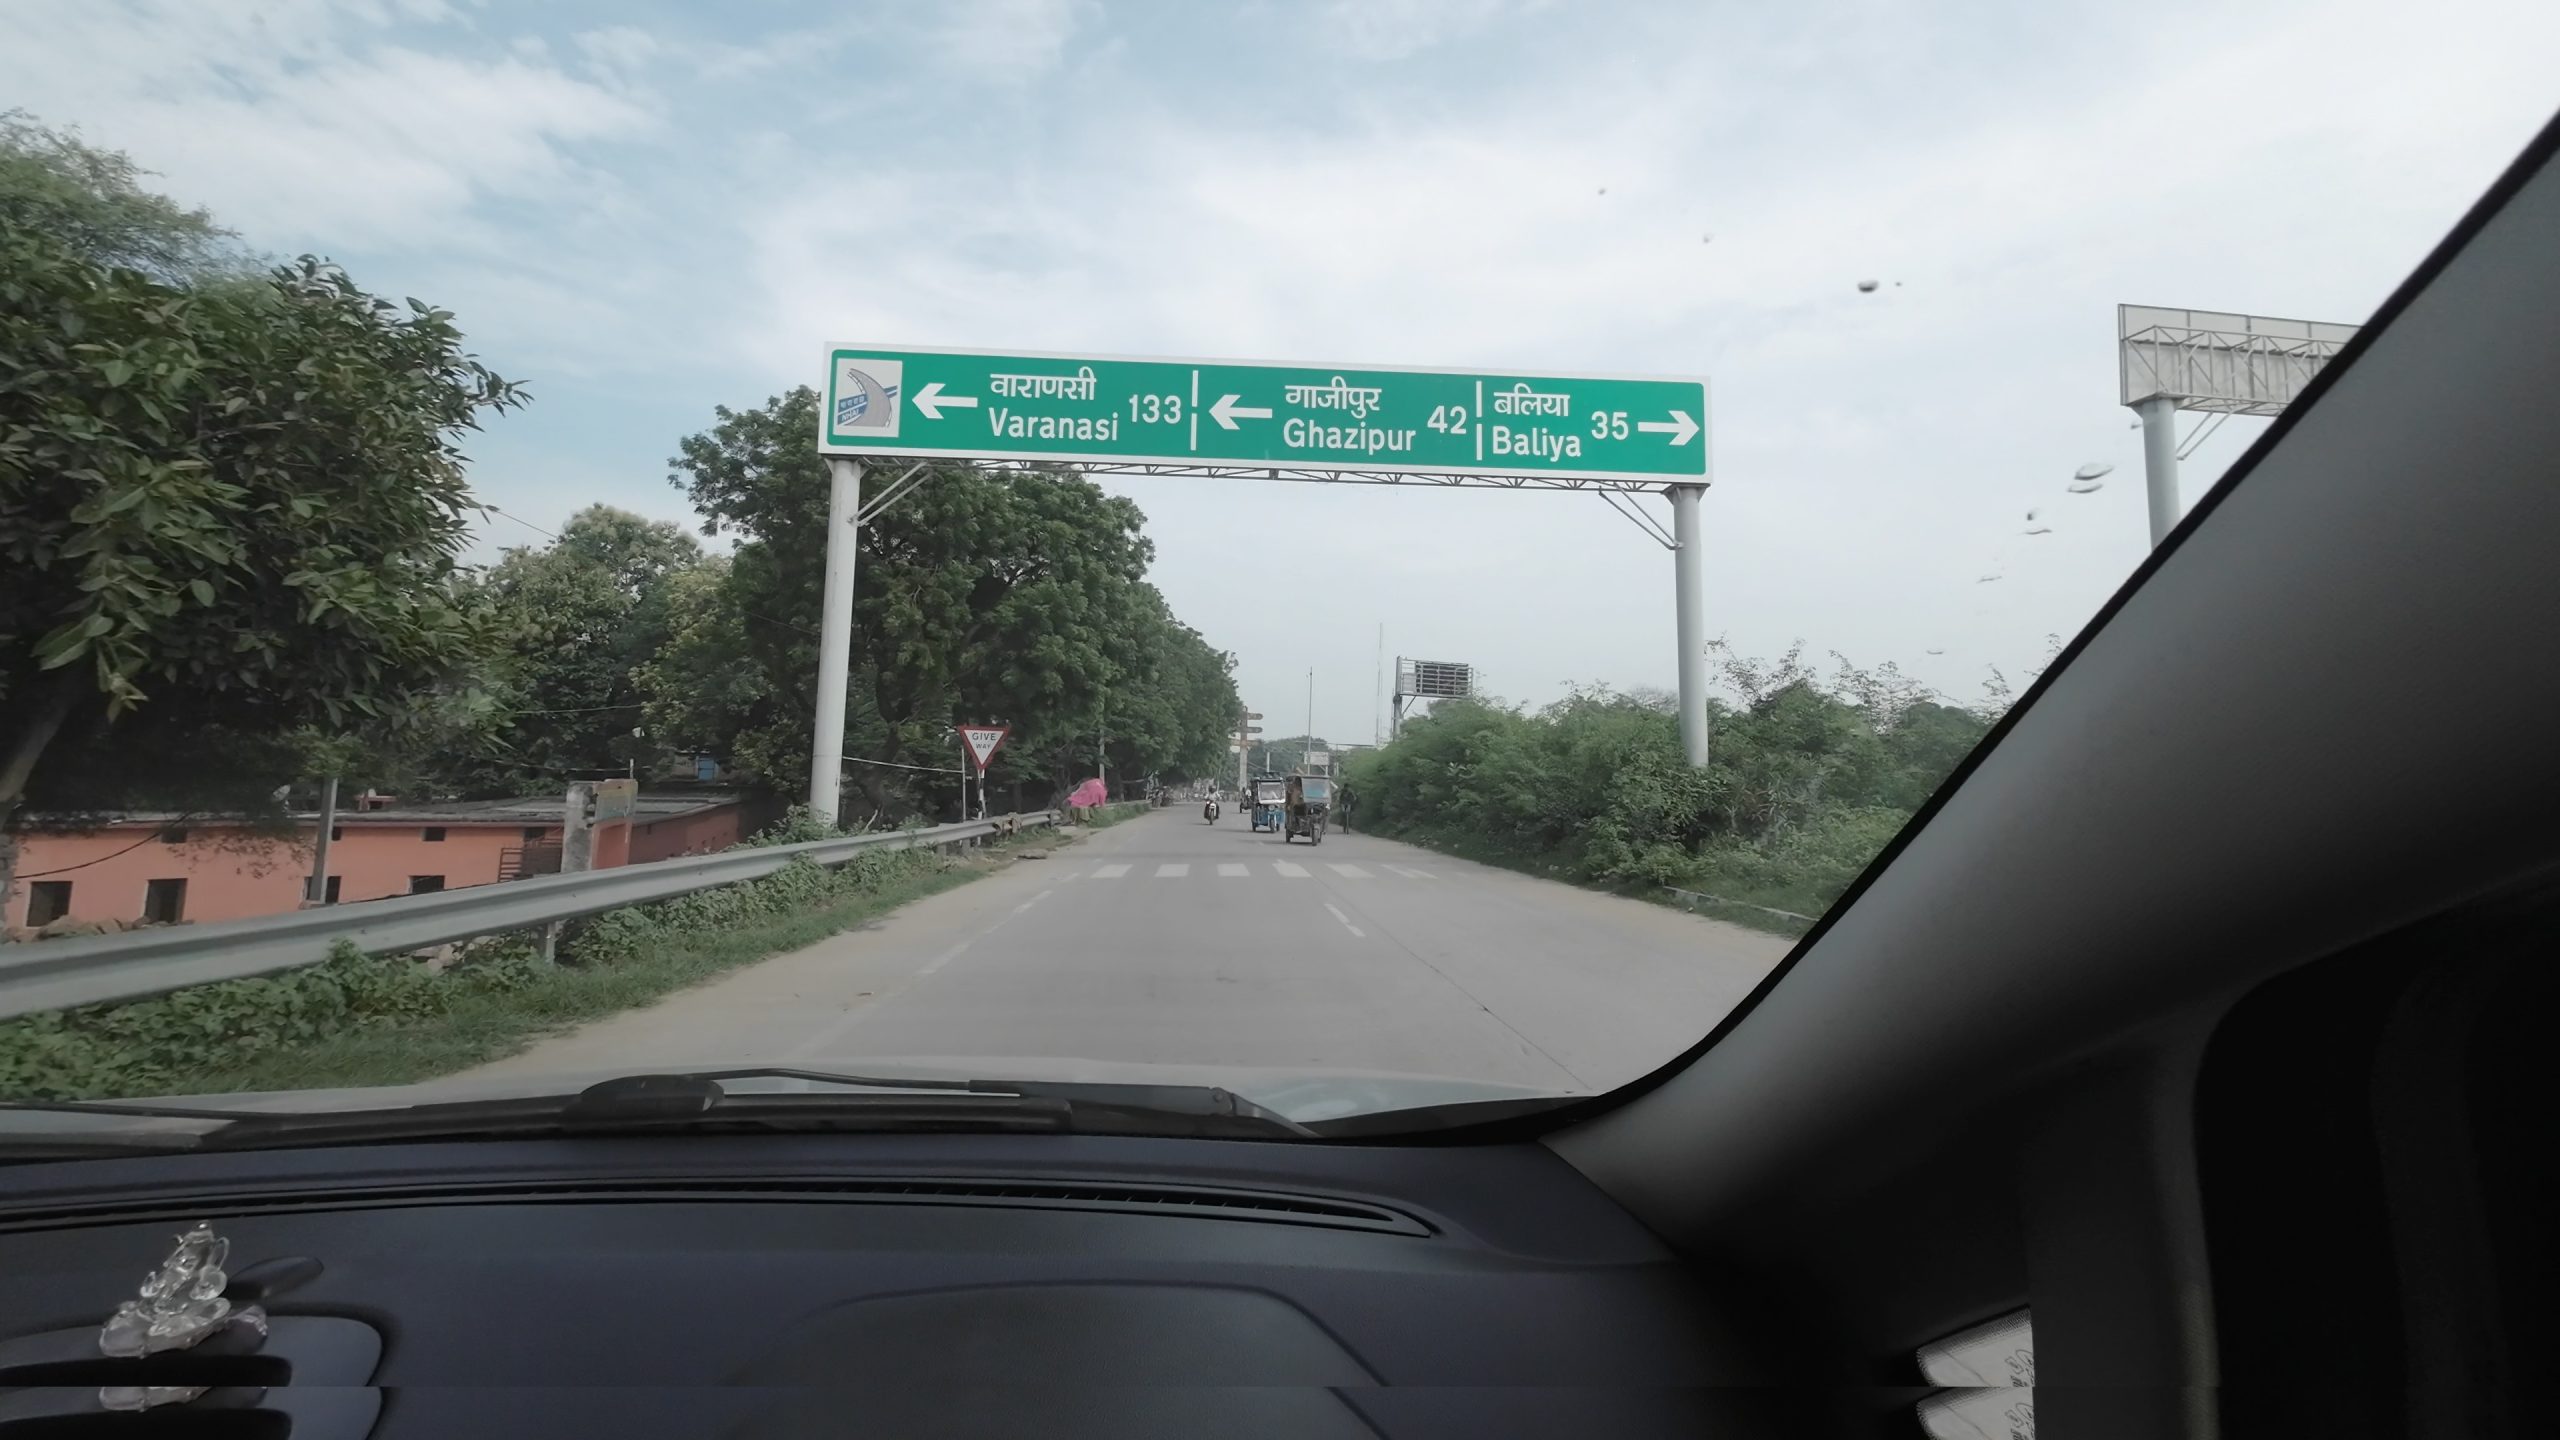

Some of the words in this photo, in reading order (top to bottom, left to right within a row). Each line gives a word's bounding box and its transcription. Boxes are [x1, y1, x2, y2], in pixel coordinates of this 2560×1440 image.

[990, 366, 1097, 401] वाराणसी
[1284, 375, 1383, 420] गाजीपुर
[1493, 382, 1571, 418] बलिया
[988, 407, 1119, 442] Varanasi
[1129, 394, 1182, 424] 133
[1427, 405, 1467, 435] 42
[1591, 410, 1629, 441] 35
[1283, 417, 1416, 456] Ghazipur
[1492, 425, 1582, 463] Baliya
[972, 732, 997, 741] GIVE
